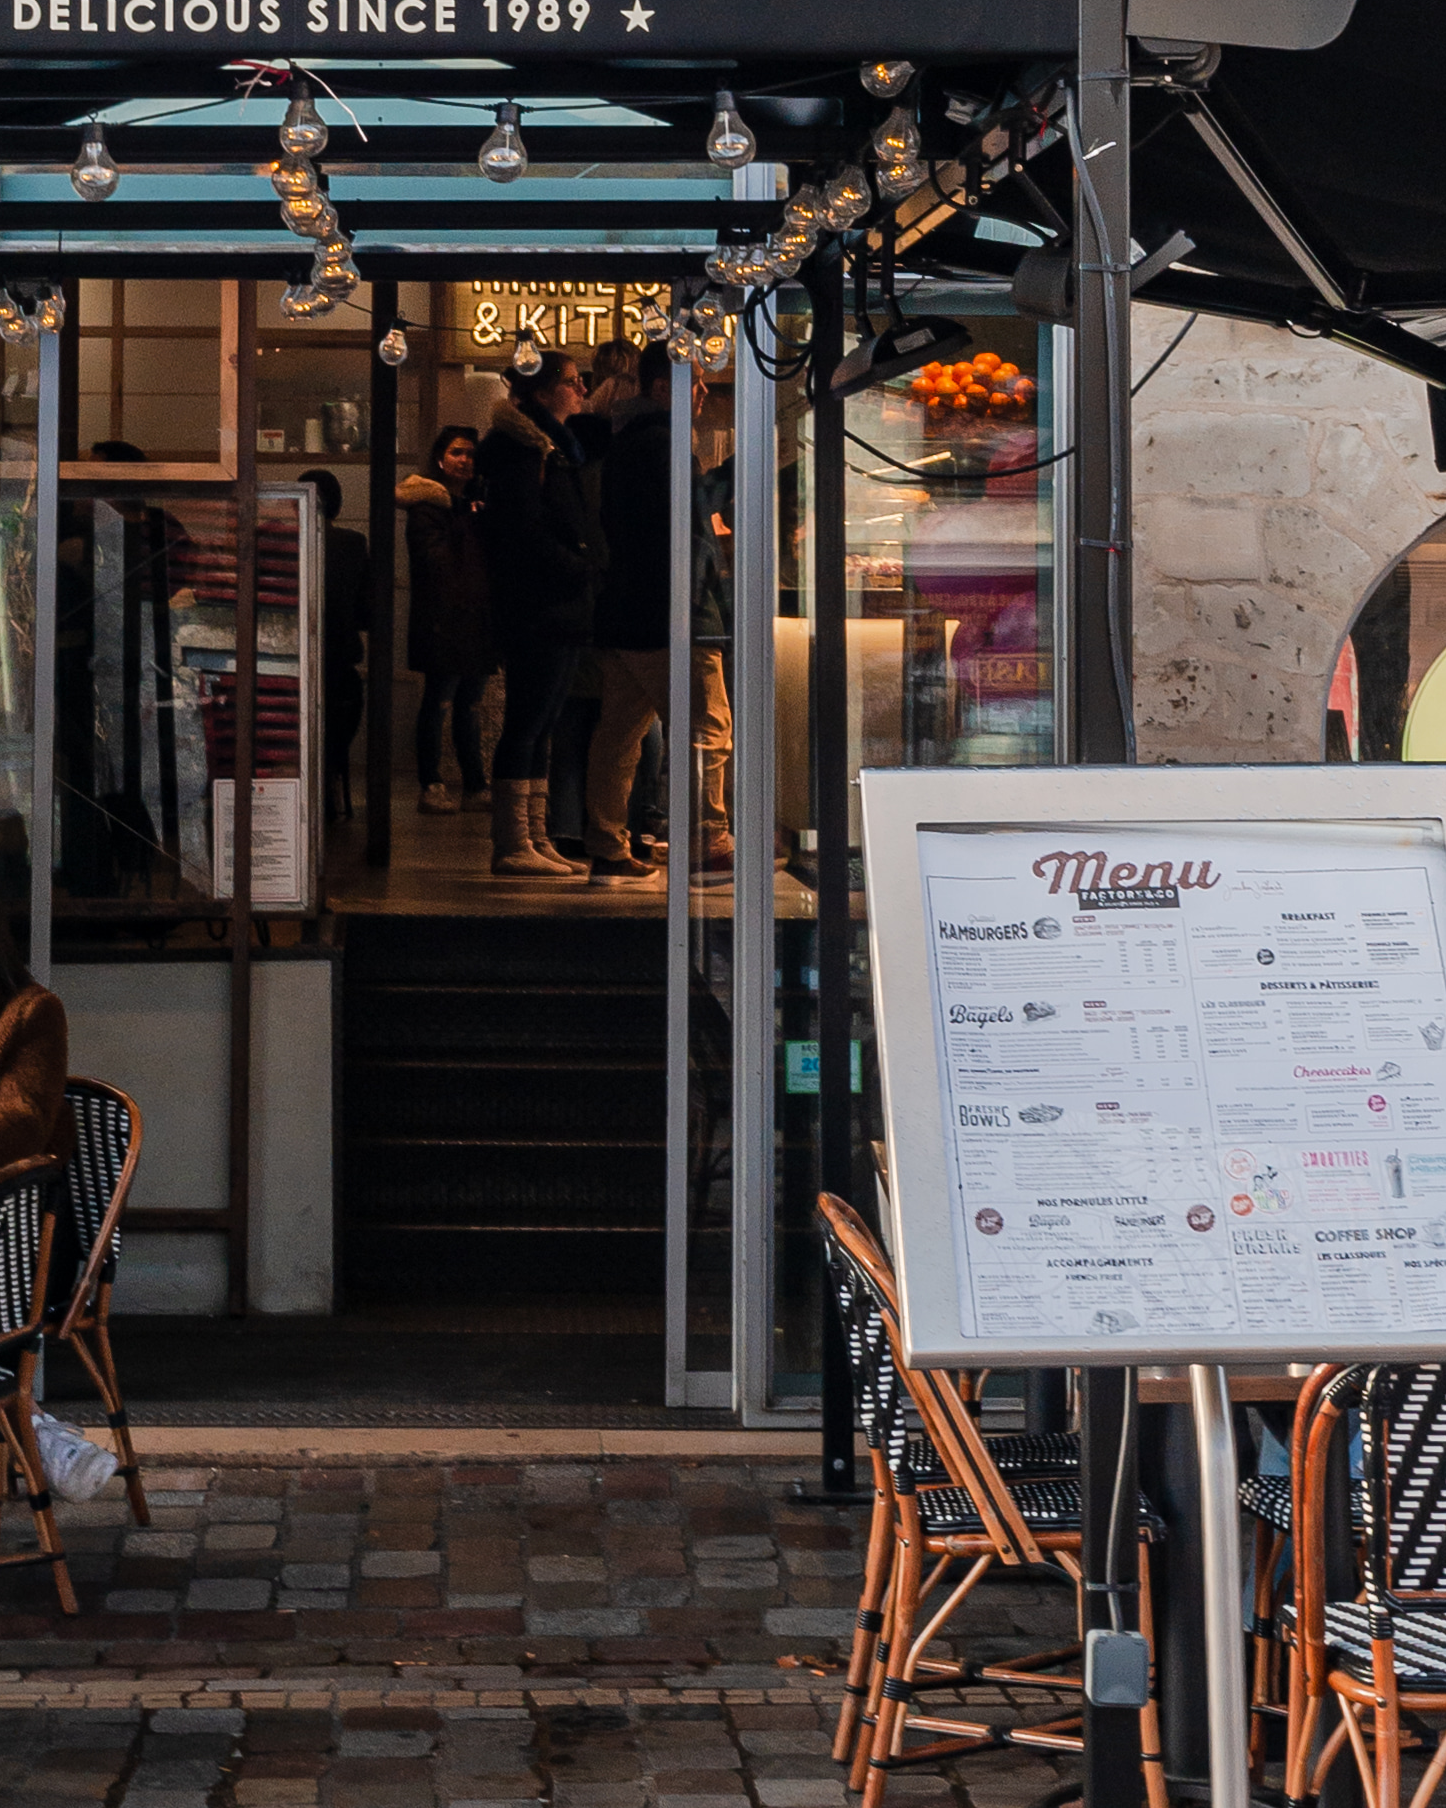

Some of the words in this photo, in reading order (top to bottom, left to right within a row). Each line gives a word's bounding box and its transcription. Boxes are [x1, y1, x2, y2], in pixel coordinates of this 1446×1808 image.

[472, 301, 503, 345] &
[1032, 851, 1221, 894] Menu
[1281, 911, 1336, 922] BREAKFAST
[938, 920, 1029, 941] HAMBURGERS
[1260, 981, 1307, 990] DESSERTS
[949, 1004, 1014, 1029] Bagels
[1293, 1064, 1371, 1079] Cheesecakes
[959, 1104, 1010, 1127] BOWLS
[1302, 1150, 1370, 1168] SMOOTHIES
[1315, 1229, 1369, 1243] COFFEE
[1375, 1227, 1417, 1241] SHOP
